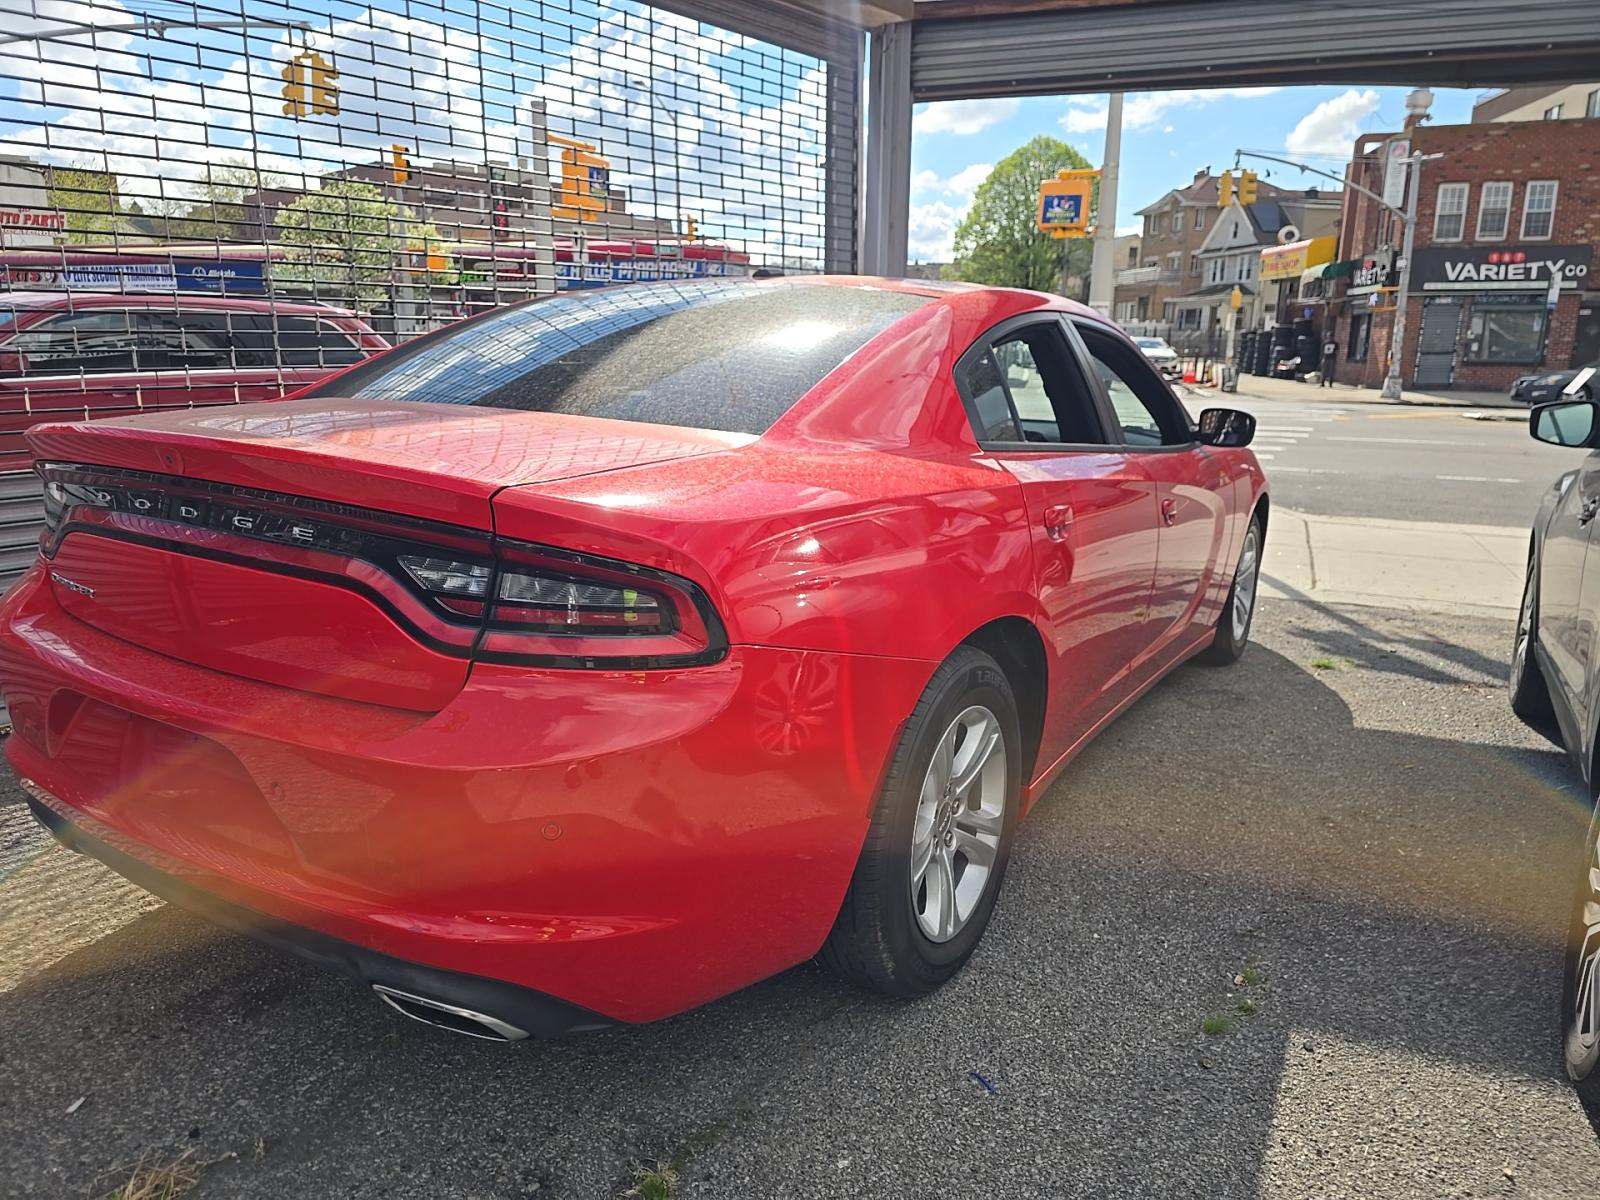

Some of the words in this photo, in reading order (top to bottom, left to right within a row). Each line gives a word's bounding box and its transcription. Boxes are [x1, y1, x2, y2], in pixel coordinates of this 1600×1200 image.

[24, 214, 65, 228] PARTS
[1444, 258, 1565, 281] VARIETY
[1565, 263, 1588, 277] CO
[97, 489, 314, 541] DODGE
